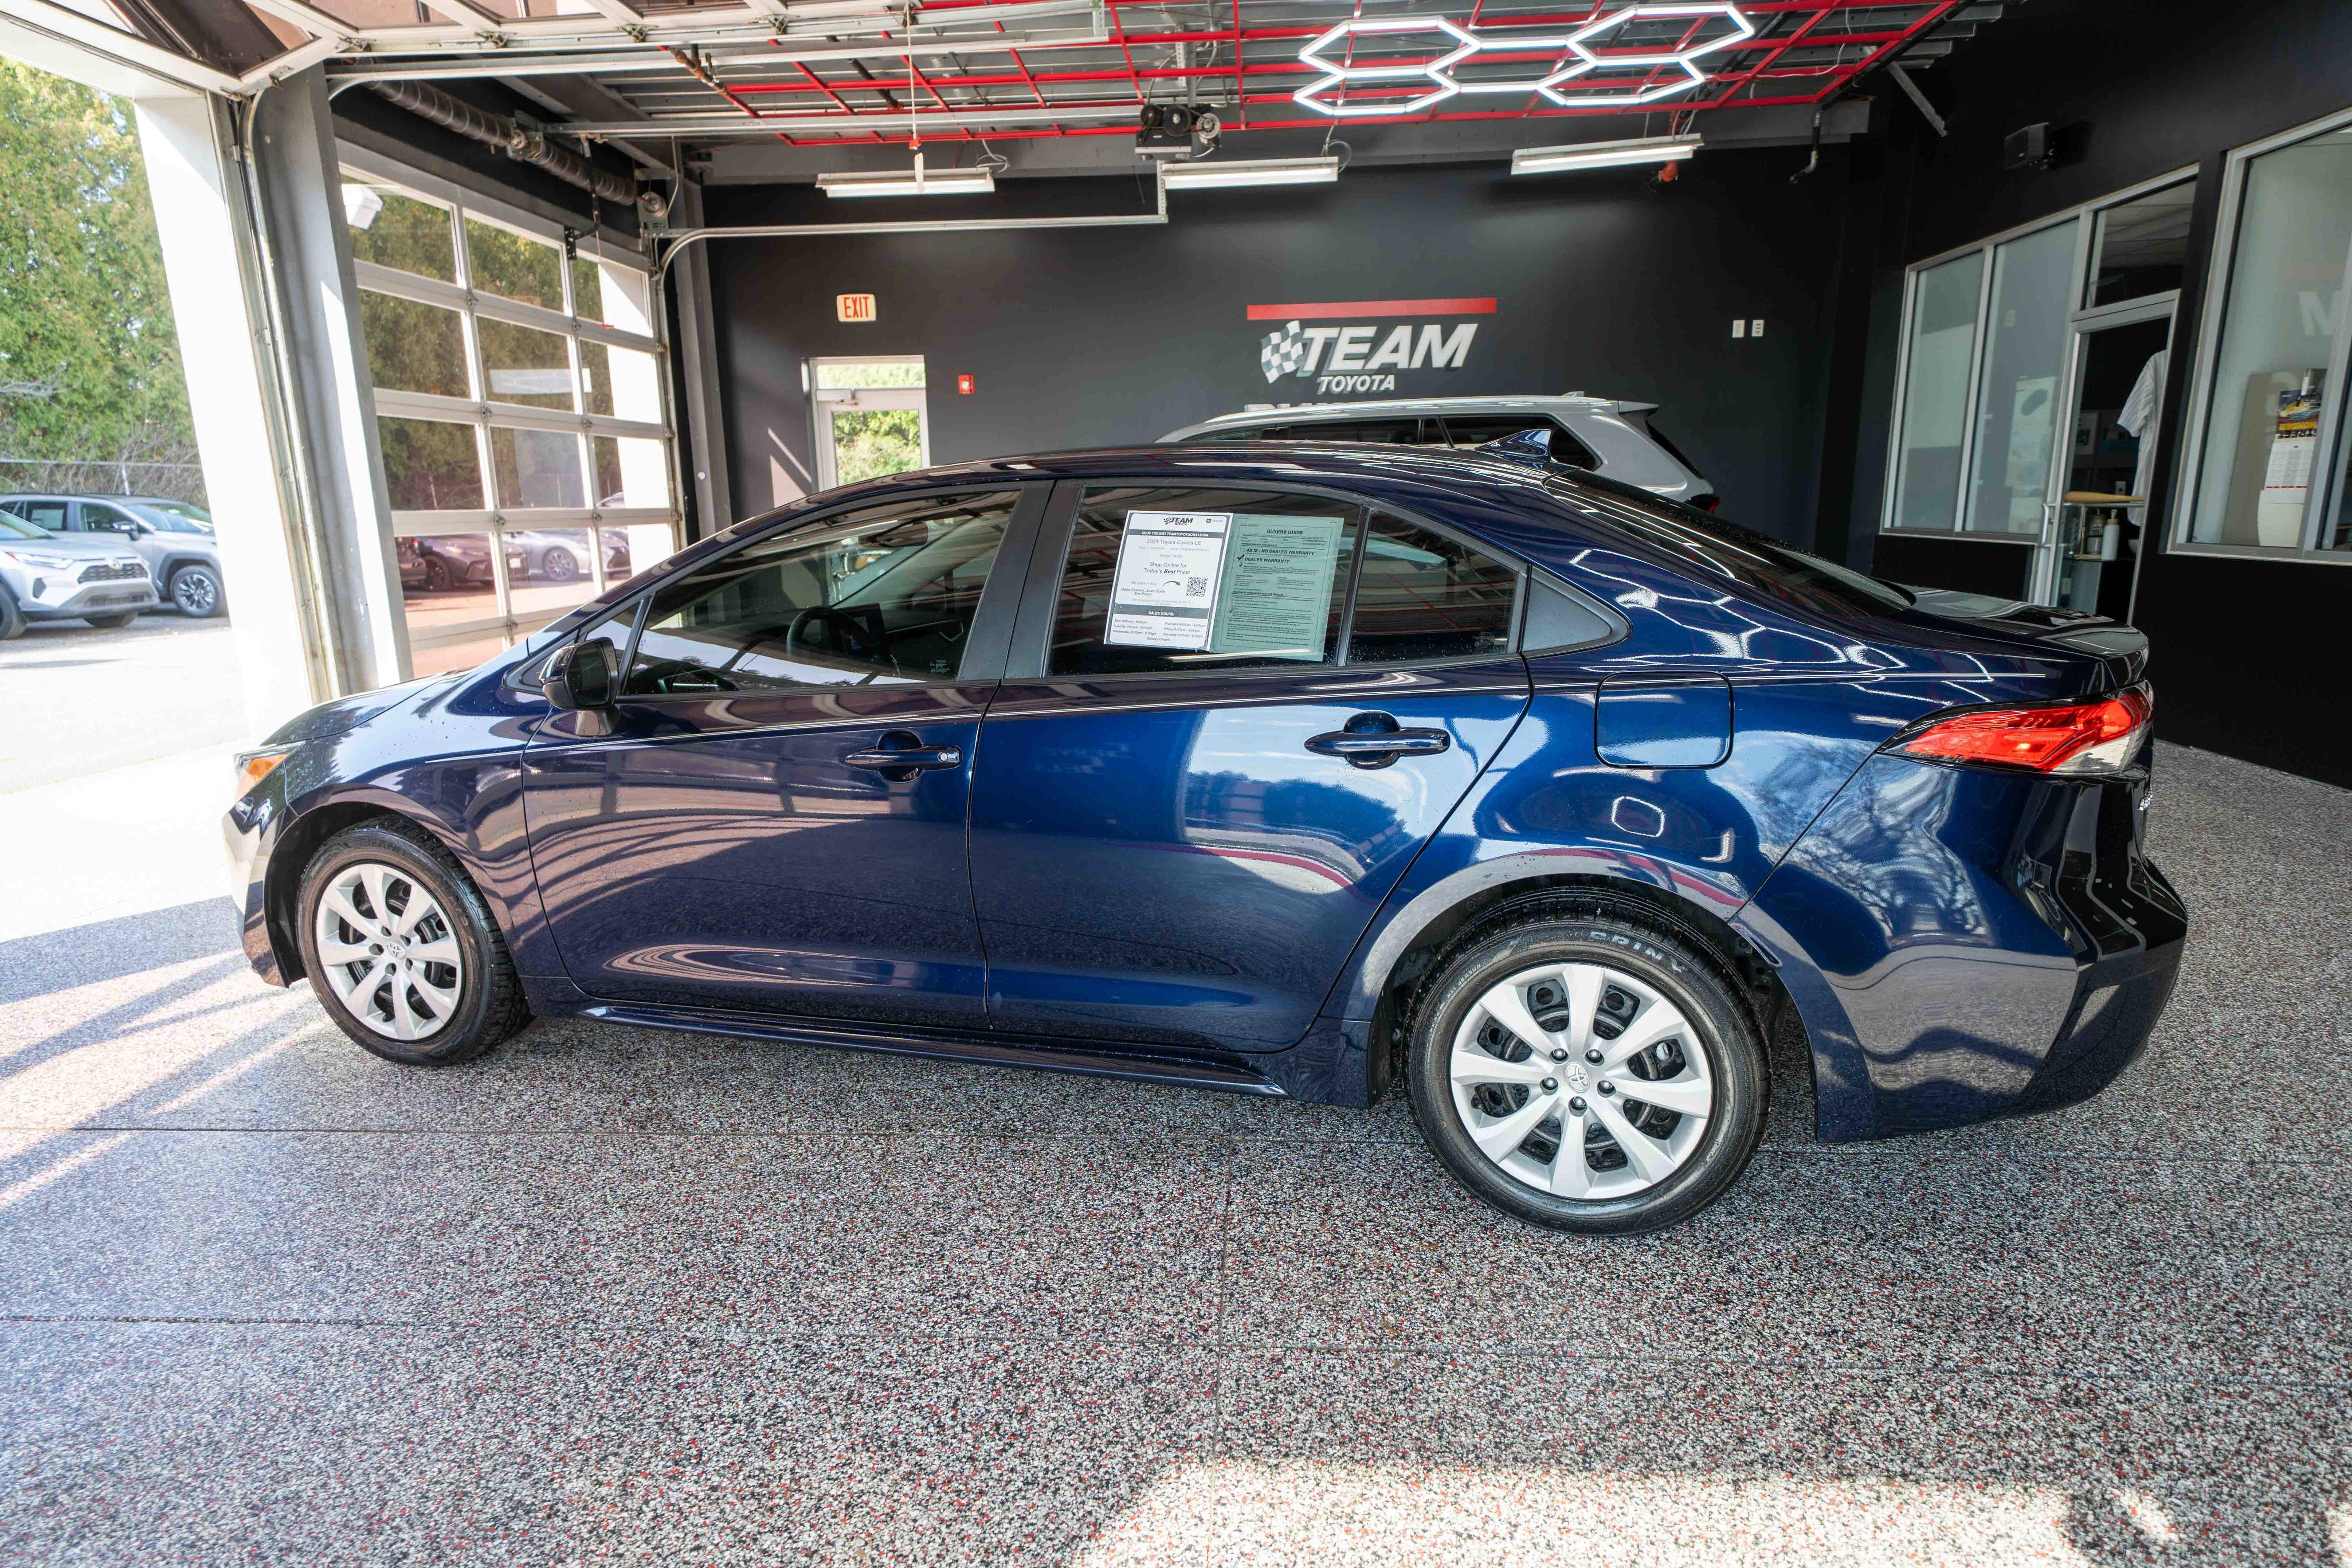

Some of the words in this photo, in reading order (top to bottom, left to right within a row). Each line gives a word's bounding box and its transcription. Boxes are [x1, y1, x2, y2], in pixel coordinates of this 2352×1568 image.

[844, 296, 869, 318] EXIT
[1302, 323, 1478, 371] TEAM
[1318, 374, 1395, 394] TOYOTA
